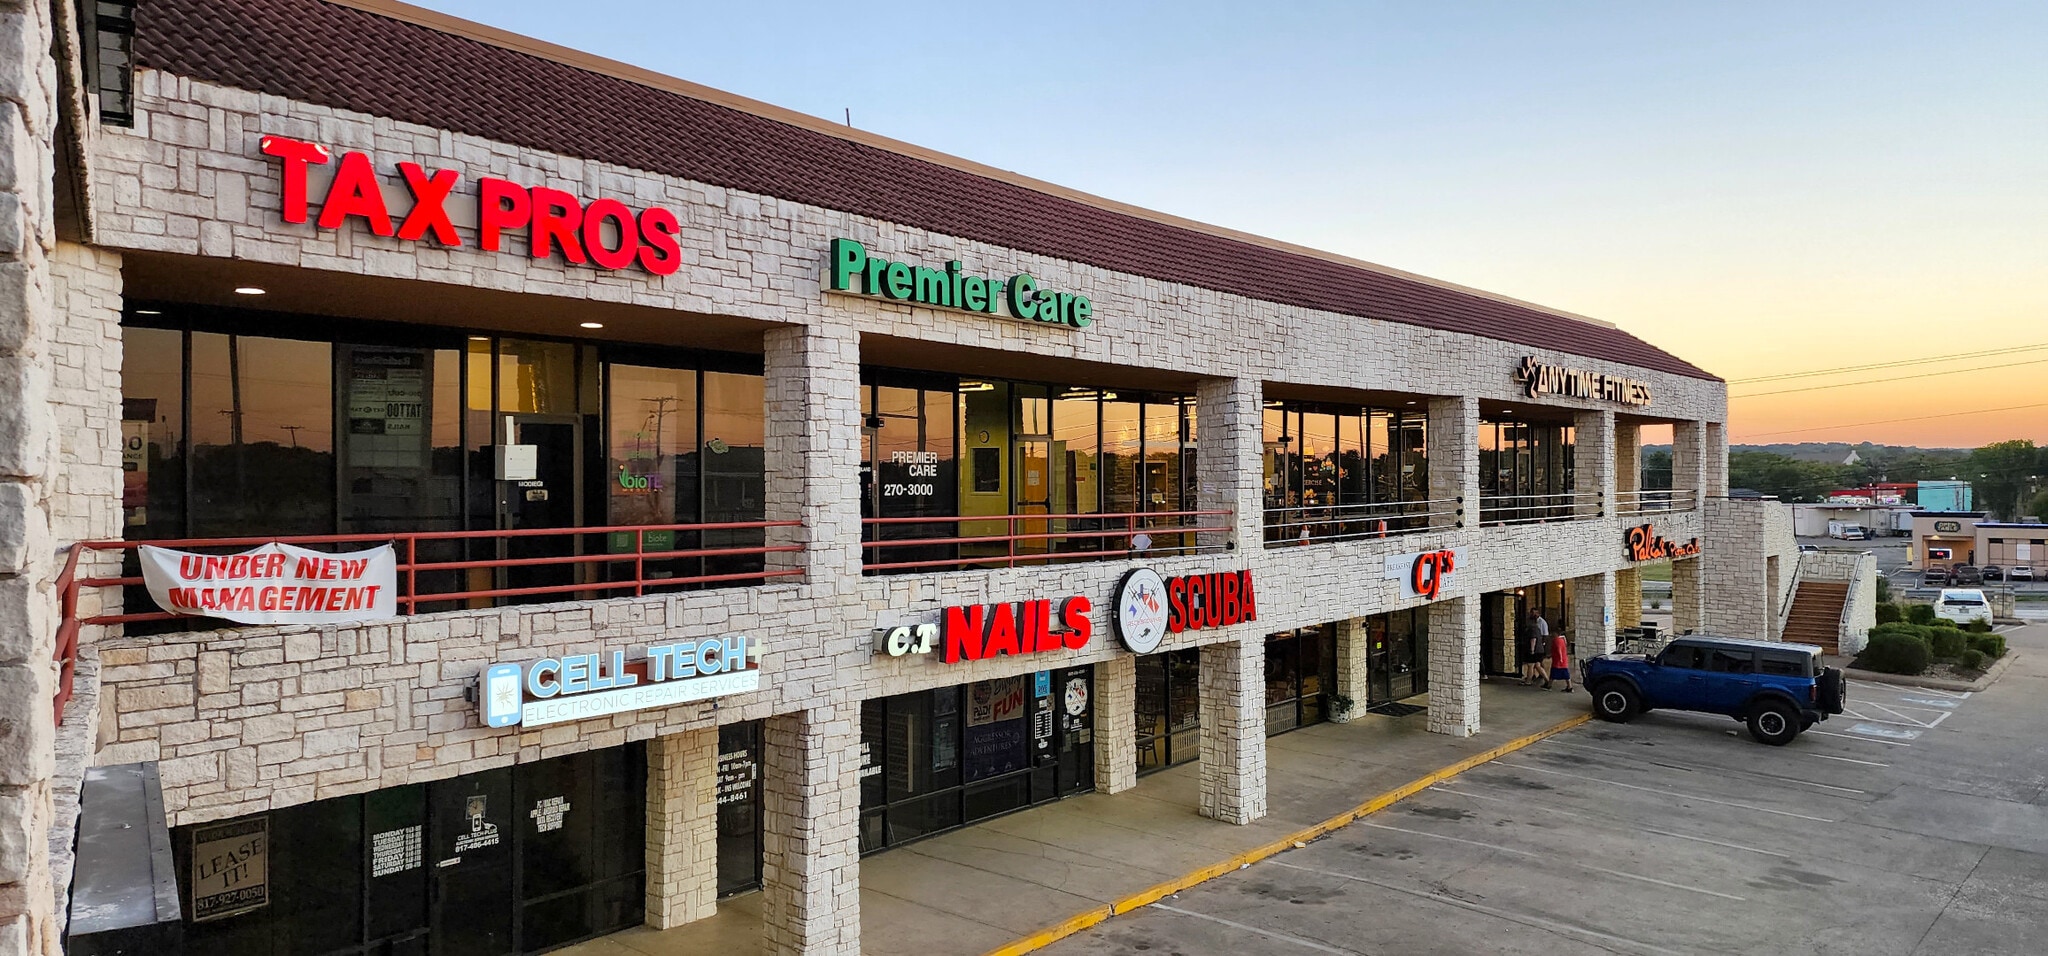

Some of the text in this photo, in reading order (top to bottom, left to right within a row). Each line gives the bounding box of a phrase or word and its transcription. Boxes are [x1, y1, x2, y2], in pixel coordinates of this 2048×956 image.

[259, 135, 682, 276] TAX PROS
[831, 238, 1092, 328] Premier Care
[1538, 364, 1651, 405] ANYTIME FITNESS
[892, 451, 938, 463] PREMIER
[909, 465, 937, 477] CARE
[884, 484, 933, 496] 270-3000
[179, 553, 369, 582] UNDER NEW
[168, 585, 381, 612] MANAGEMENT
[1167, 569, 1257, 634] SCUBA
[942, 596, 1092, 664] NAILS
[525, 650, 638, 698] CELL
[525, 674, 758, 722] ELECTRONIC REPAIR SERVICES
[993, 688, 1022, 721] FUN
[199, 838, 264, 880] LEASE
